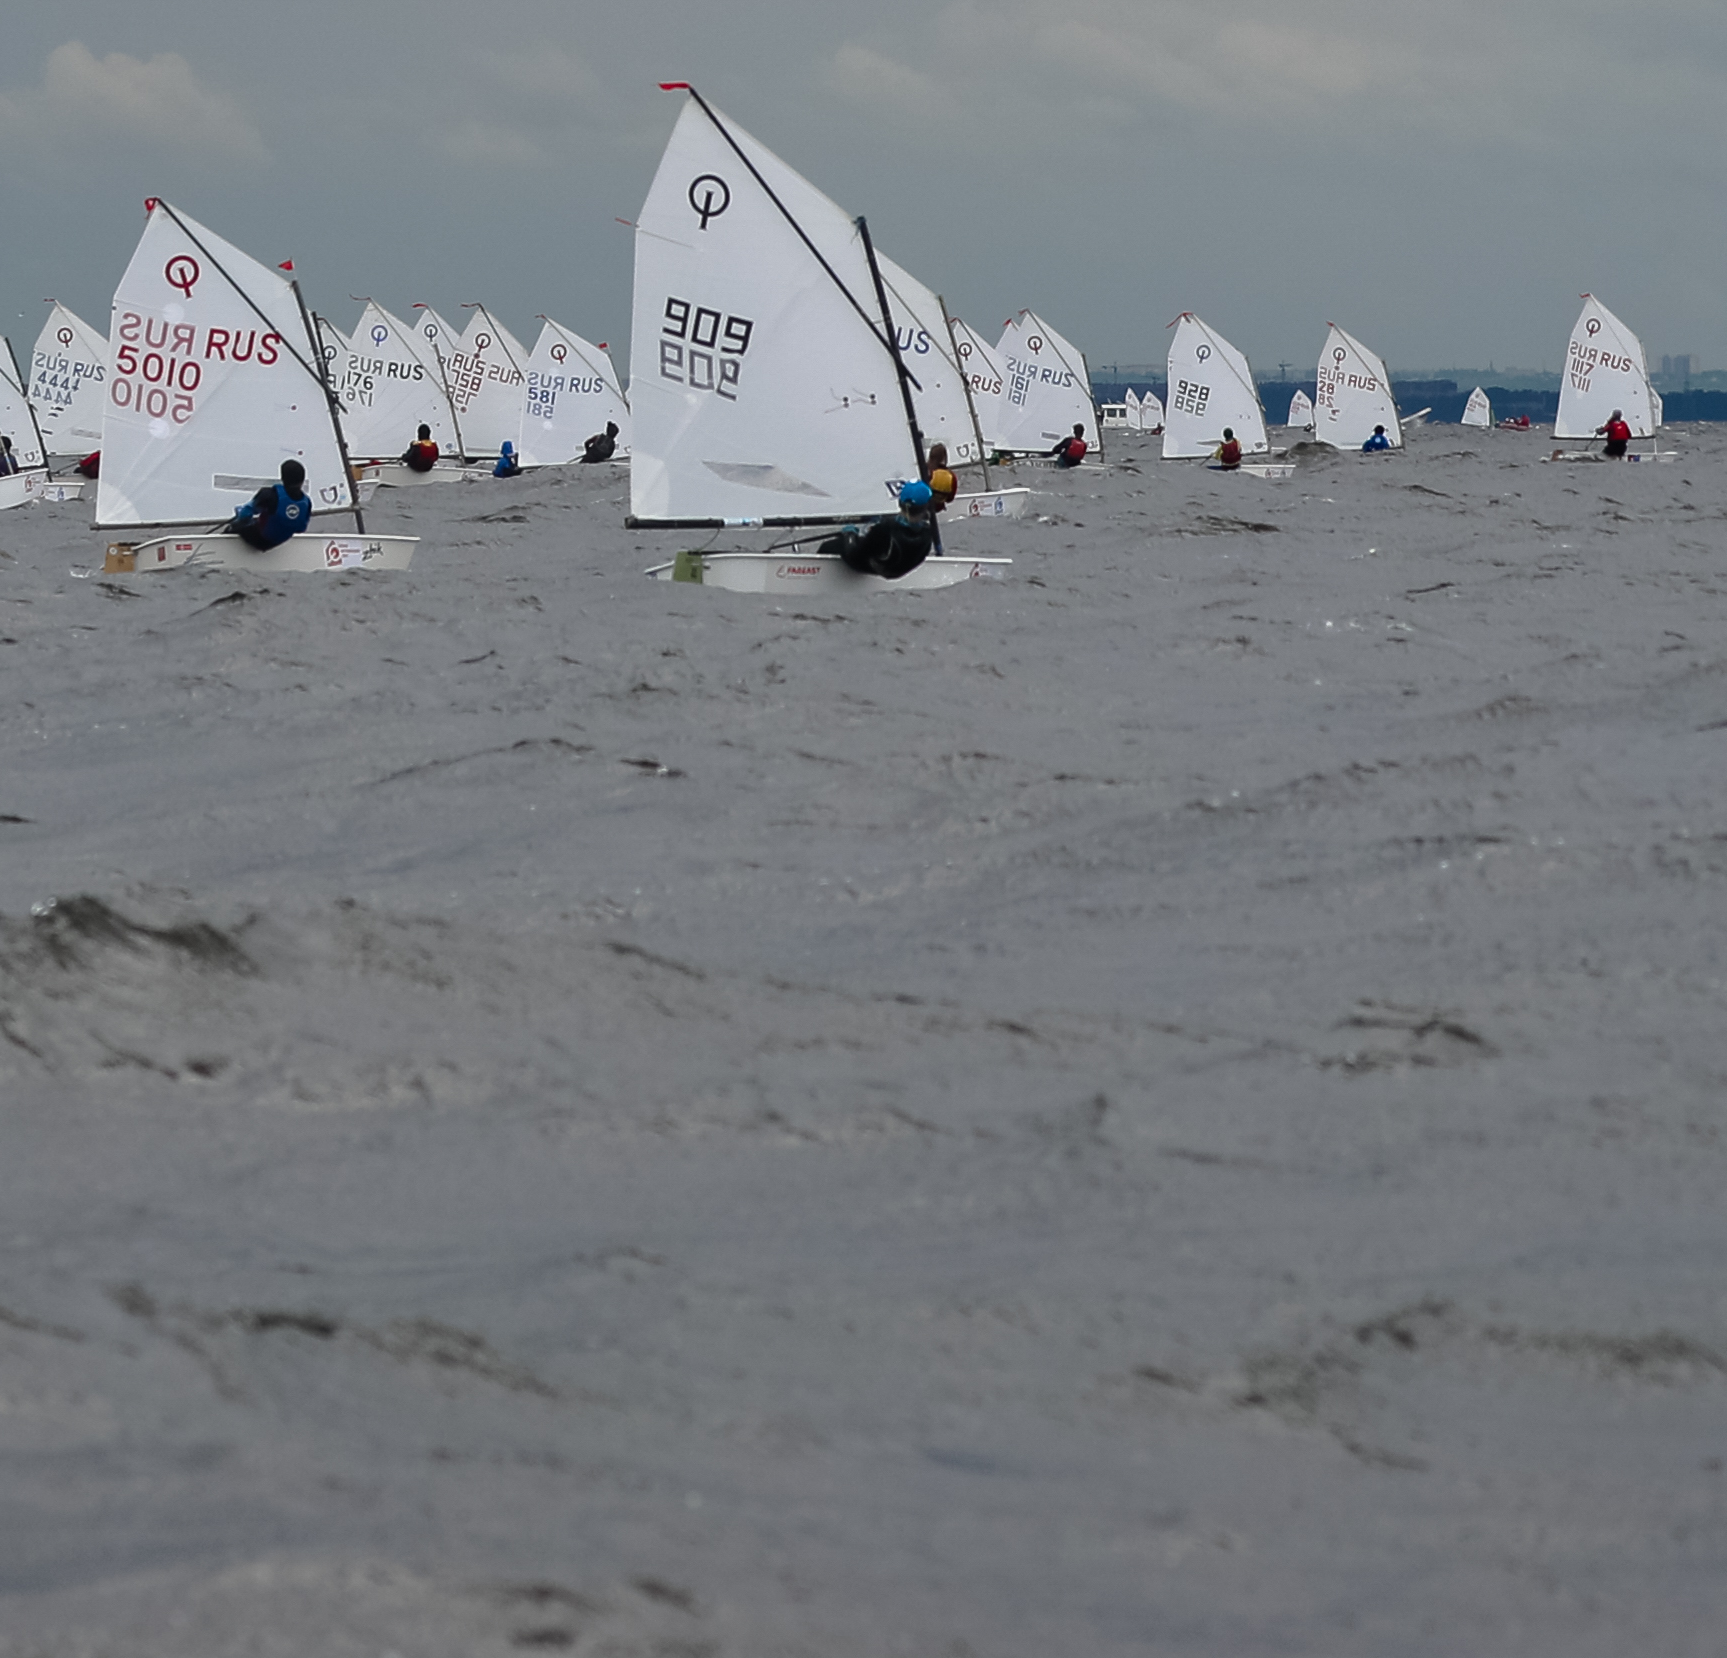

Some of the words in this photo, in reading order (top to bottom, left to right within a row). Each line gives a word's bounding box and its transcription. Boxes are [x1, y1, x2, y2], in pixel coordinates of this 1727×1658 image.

[662, 296, 754, 356] 909
[205, 328, 281, 365] RUS
[73, 362, 106, 382] RUS
[116, 344, 201, 391] 5010
[387, 362, 423, 381] RUS
[452, 353, 486, 376] RUS
[1571, 357, 1595, 376] 1117
[1599, 351, 1633, 373] RUS
[347, 370, 373, 390] 176
[451, 369, 482, 392] 758
[569, 377, 604, 393] RUS
[971, 374, 1003, 395] RUS
[1011, 374, 1030, 392] 161
[1041, 368, 1074, 387] RUS
[1347, 373, 1377, 392] RUS
[528, 387, 556, 405] 581
[1177, 379, 1210, 402] 928
